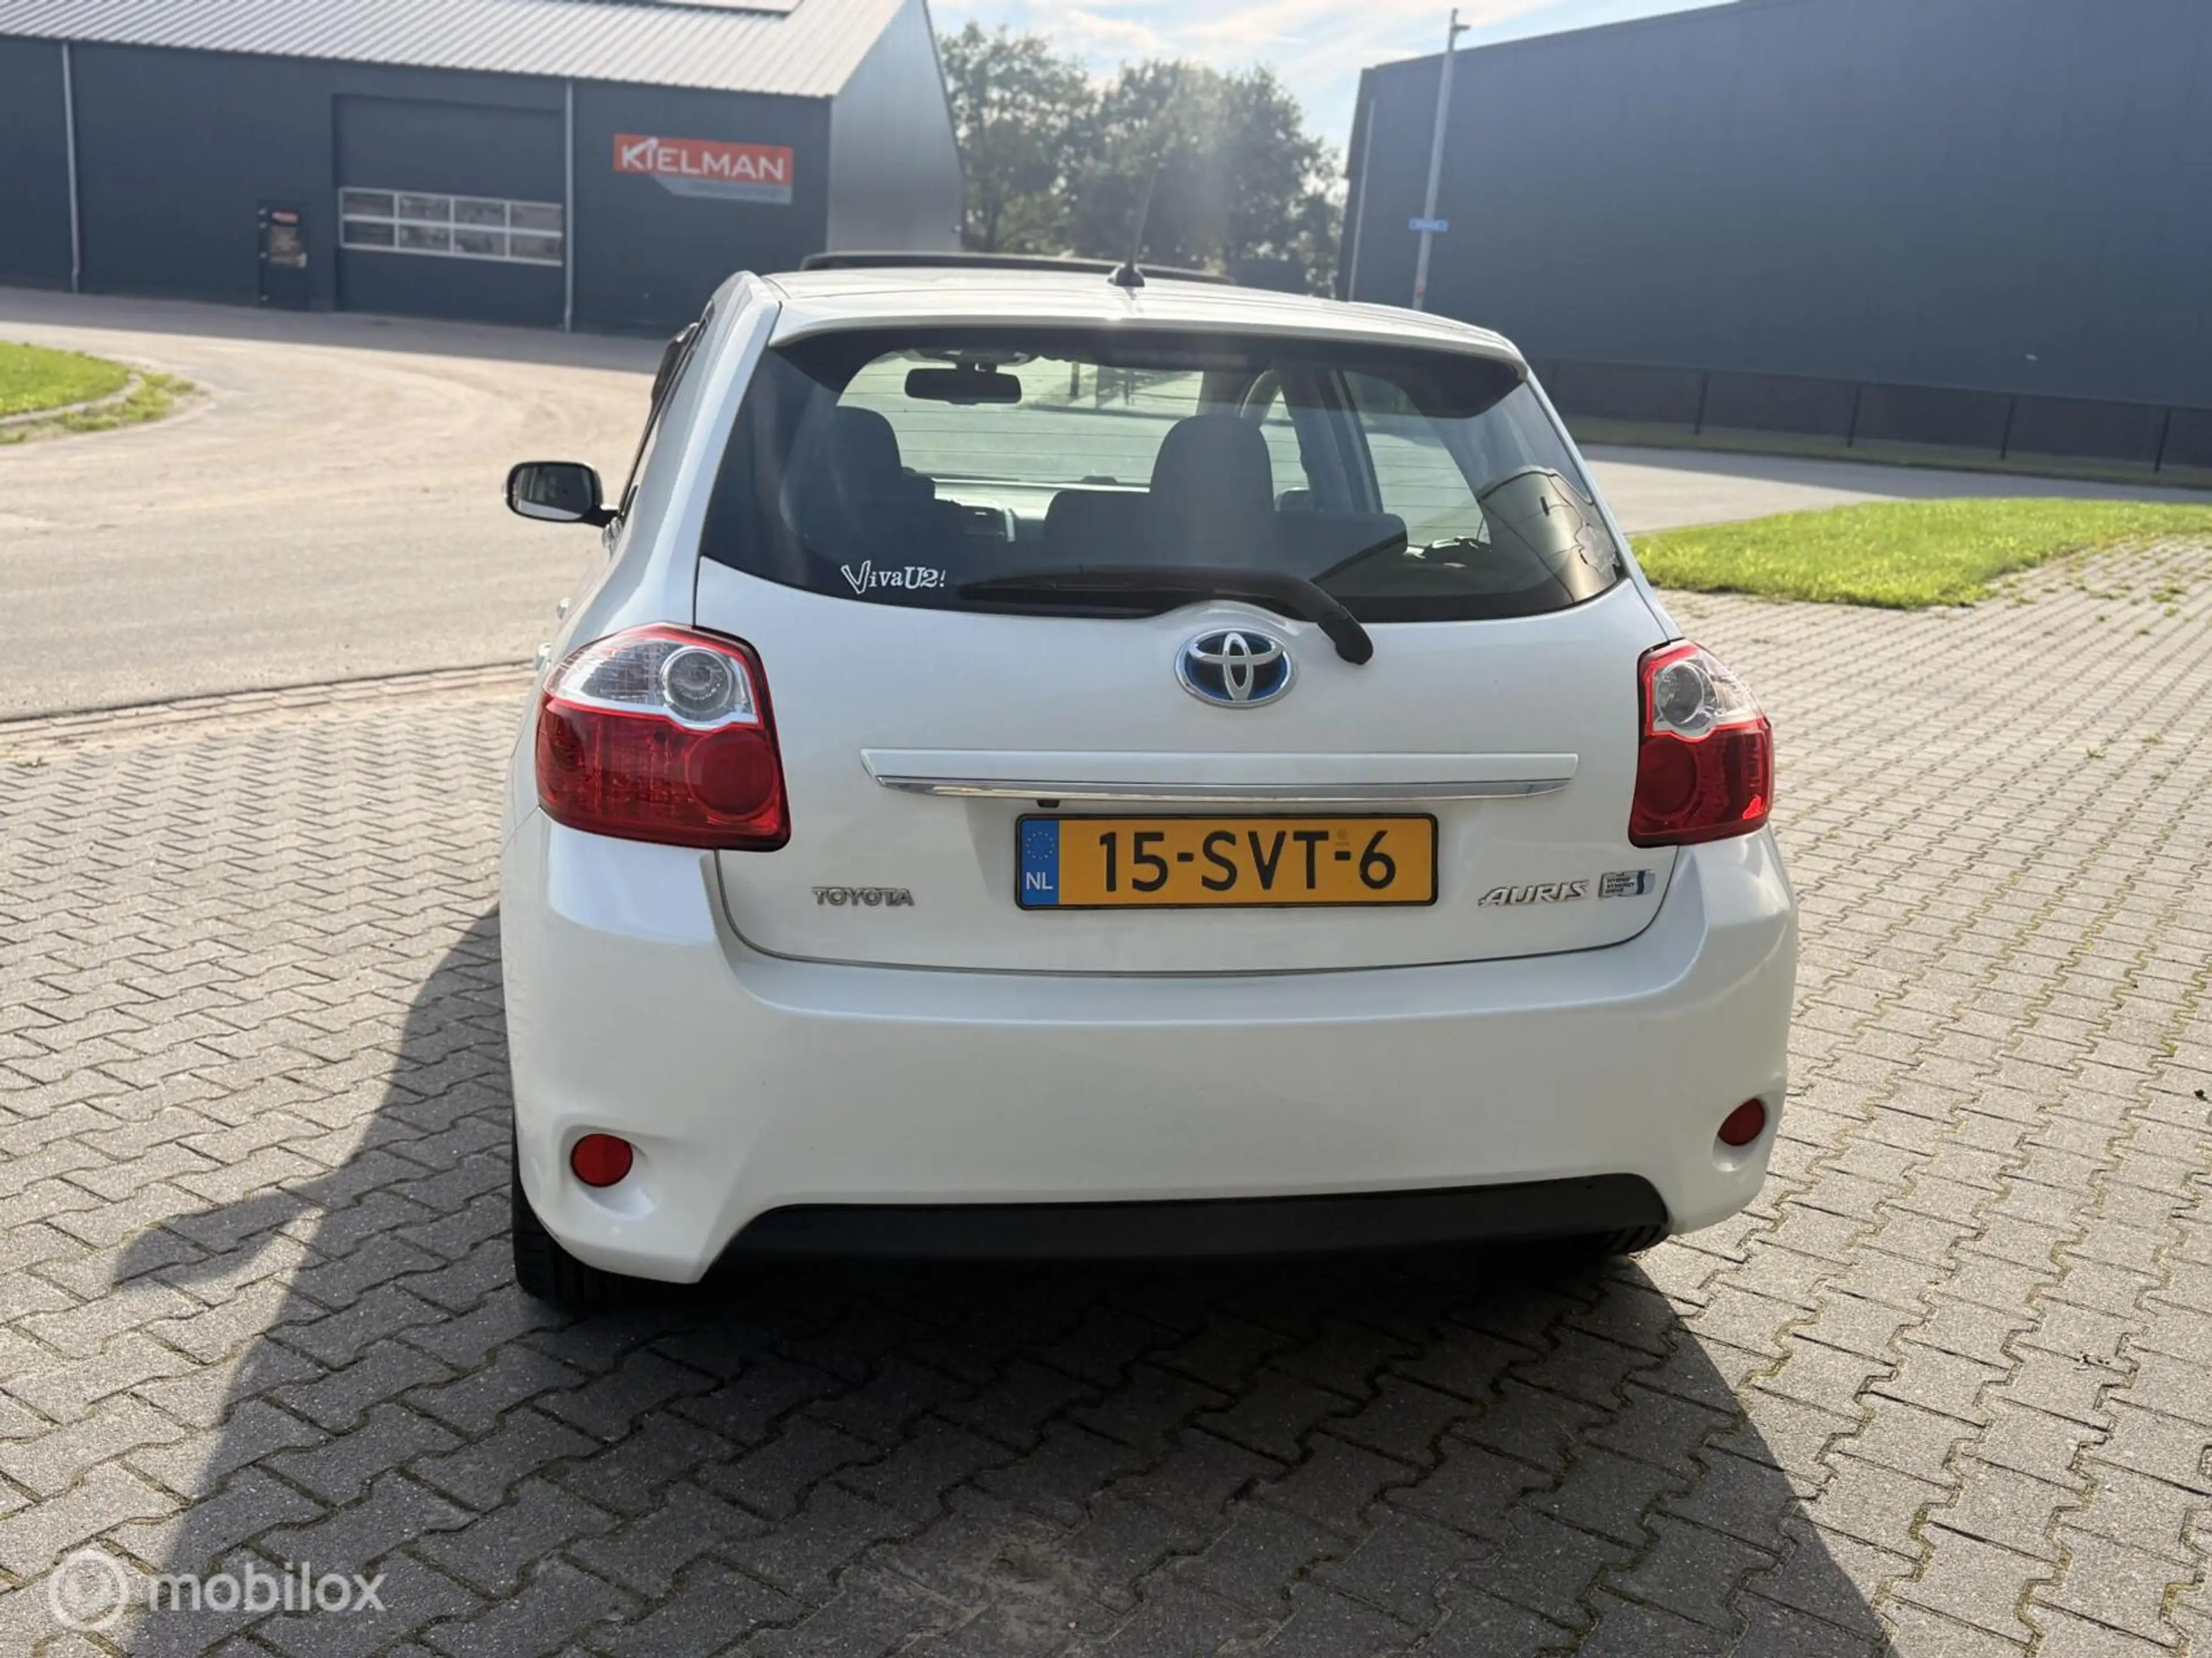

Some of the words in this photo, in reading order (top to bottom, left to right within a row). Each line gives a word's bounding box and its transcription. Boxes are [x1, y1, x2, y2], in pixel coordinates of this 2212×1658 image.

[621, 137, 784, 181] KIELMAN
[1100, 829, 1396, 892] 15-SVT-6
[1025, 871, 1054, 890] NL
[1478, 879, 1590, 907] AURIS
[811, 886, 915, 906] TOYOTA
